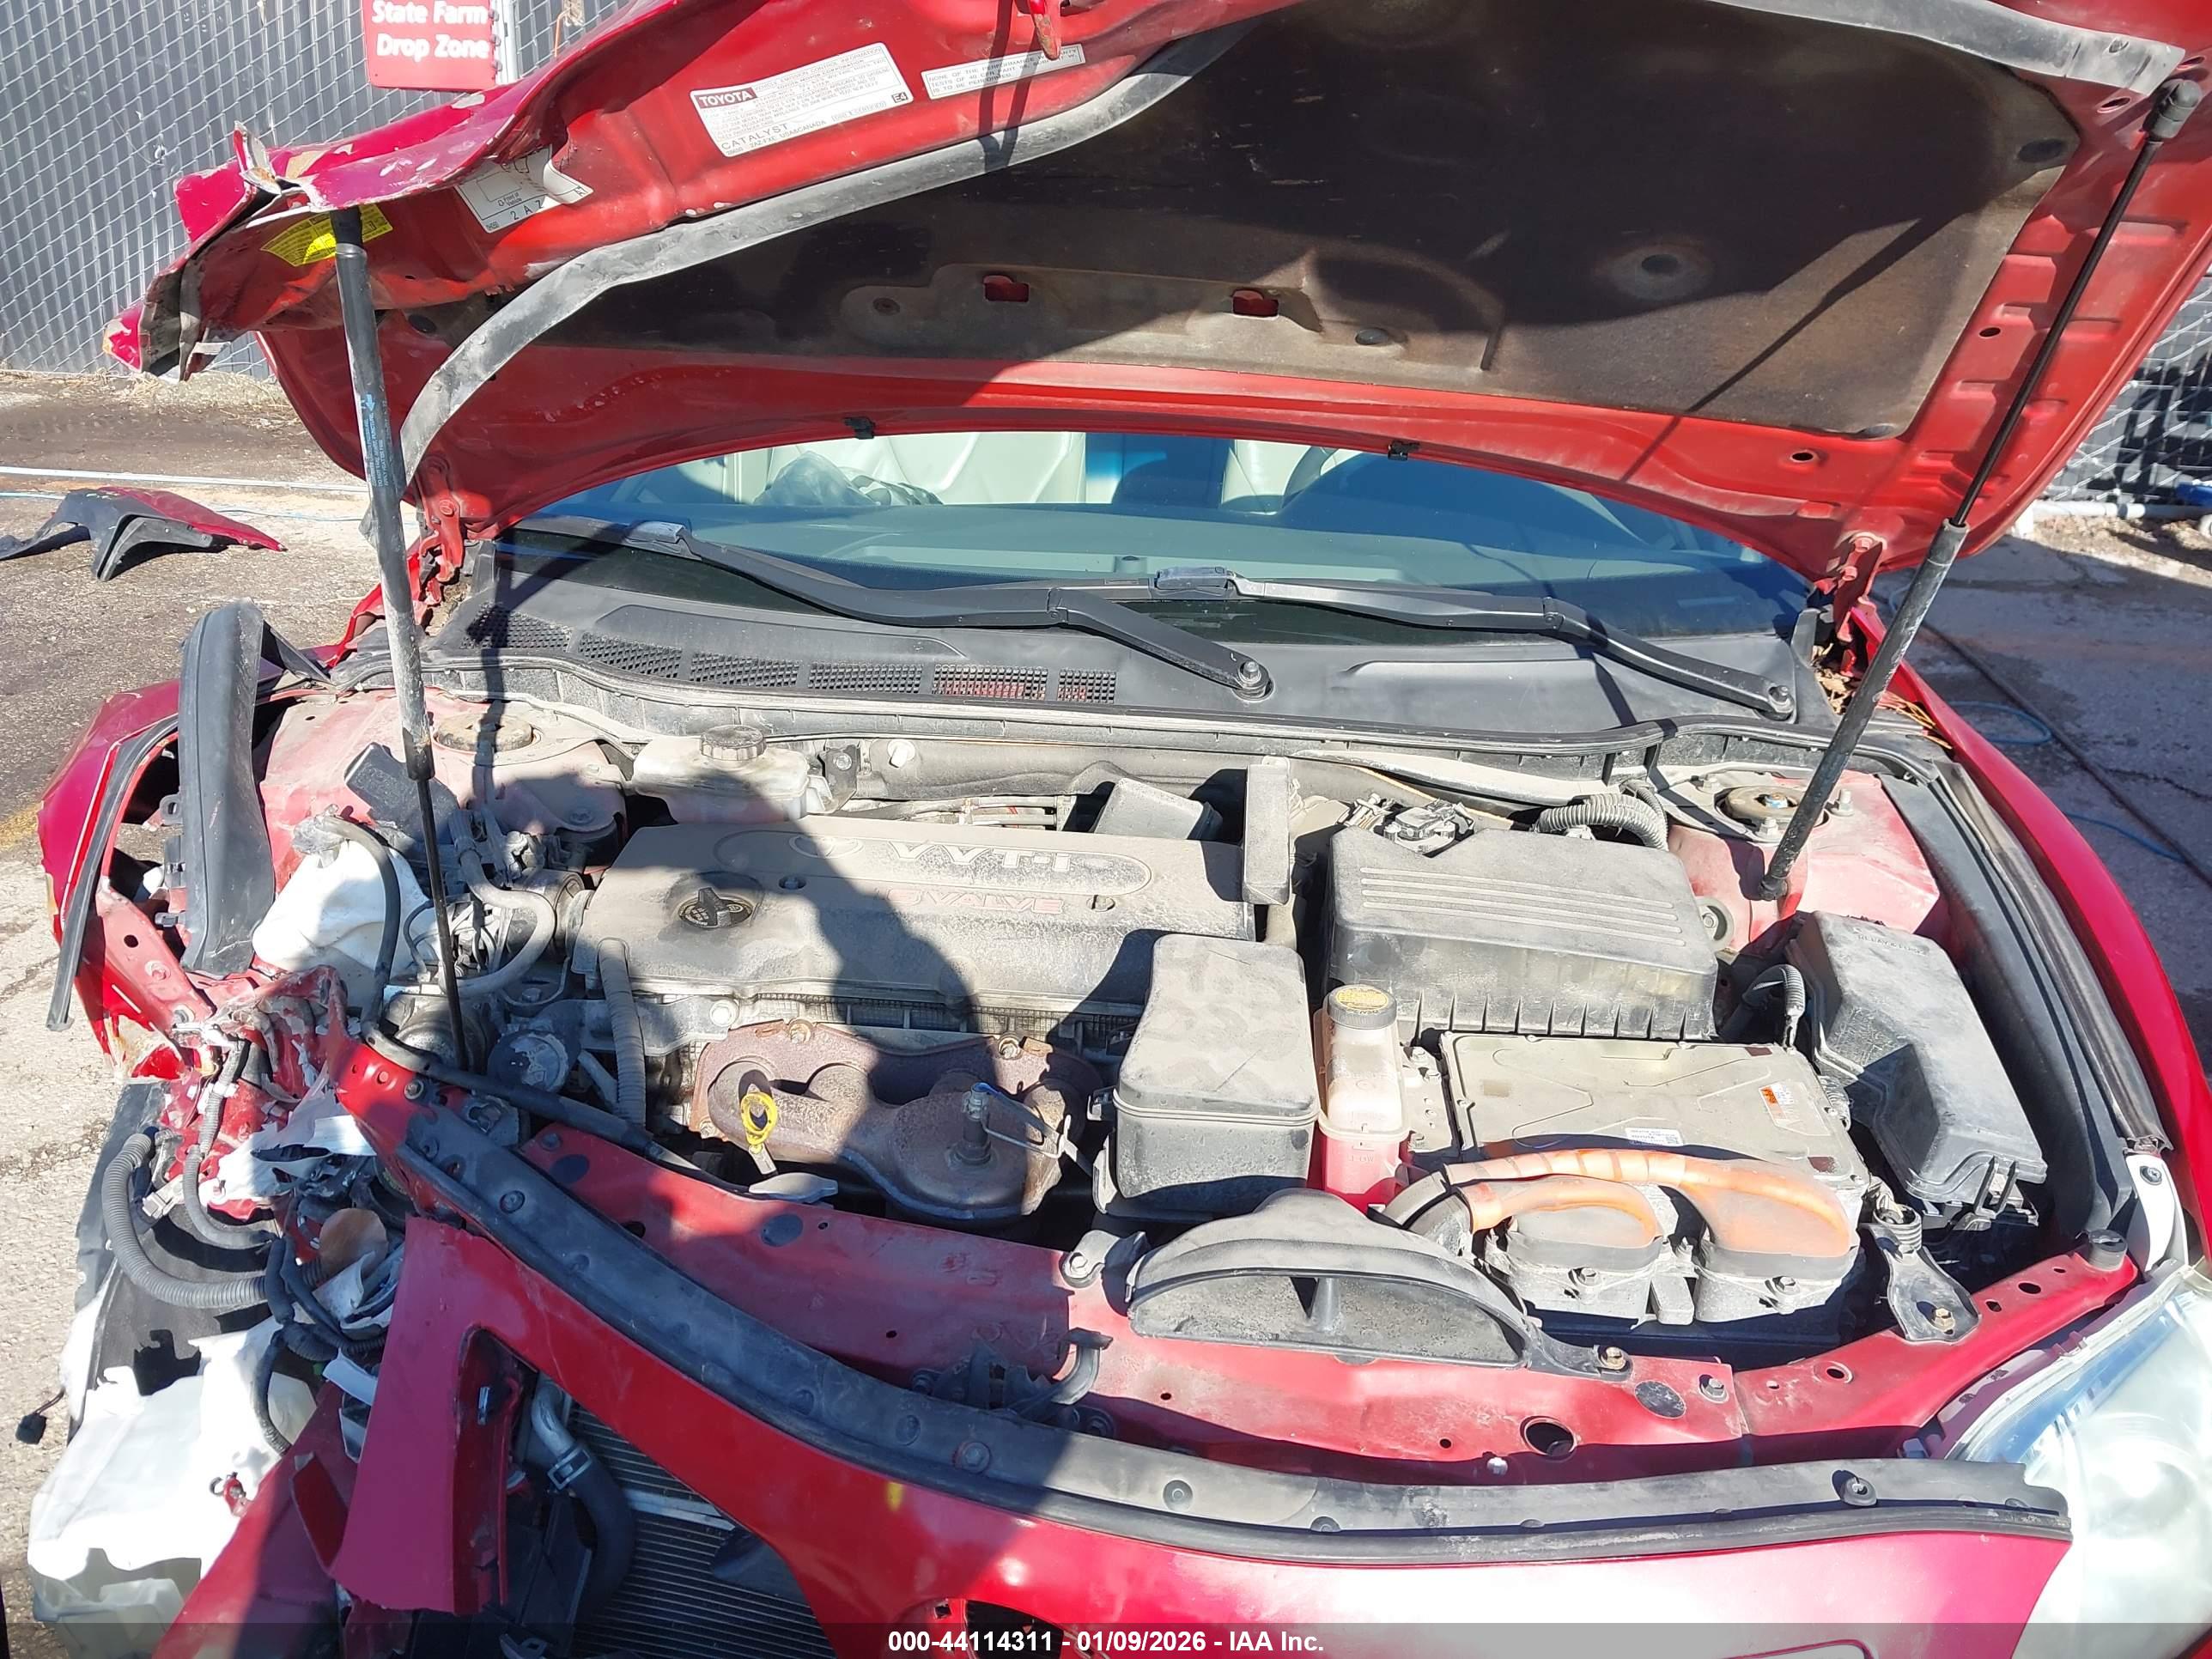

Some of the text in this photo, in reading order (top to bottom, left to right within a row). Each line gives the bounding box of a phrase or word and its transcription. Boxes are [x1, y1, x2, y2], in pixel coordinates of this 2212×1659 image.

[372, 1, 489, 24] State Farm
[376, 33, 490, 62] Drop Zone
[699, 90, 753, 106] TOYOTA
[894, 93, 907, 101] E4
[721, 122, 789, 150] CATALYST
[510, 210, 520, 221] 2
[524, 205, 533, 216] A
[886, 840, 1072, 873] VVT-i
[922, 890, 1065, 915] VALVE
